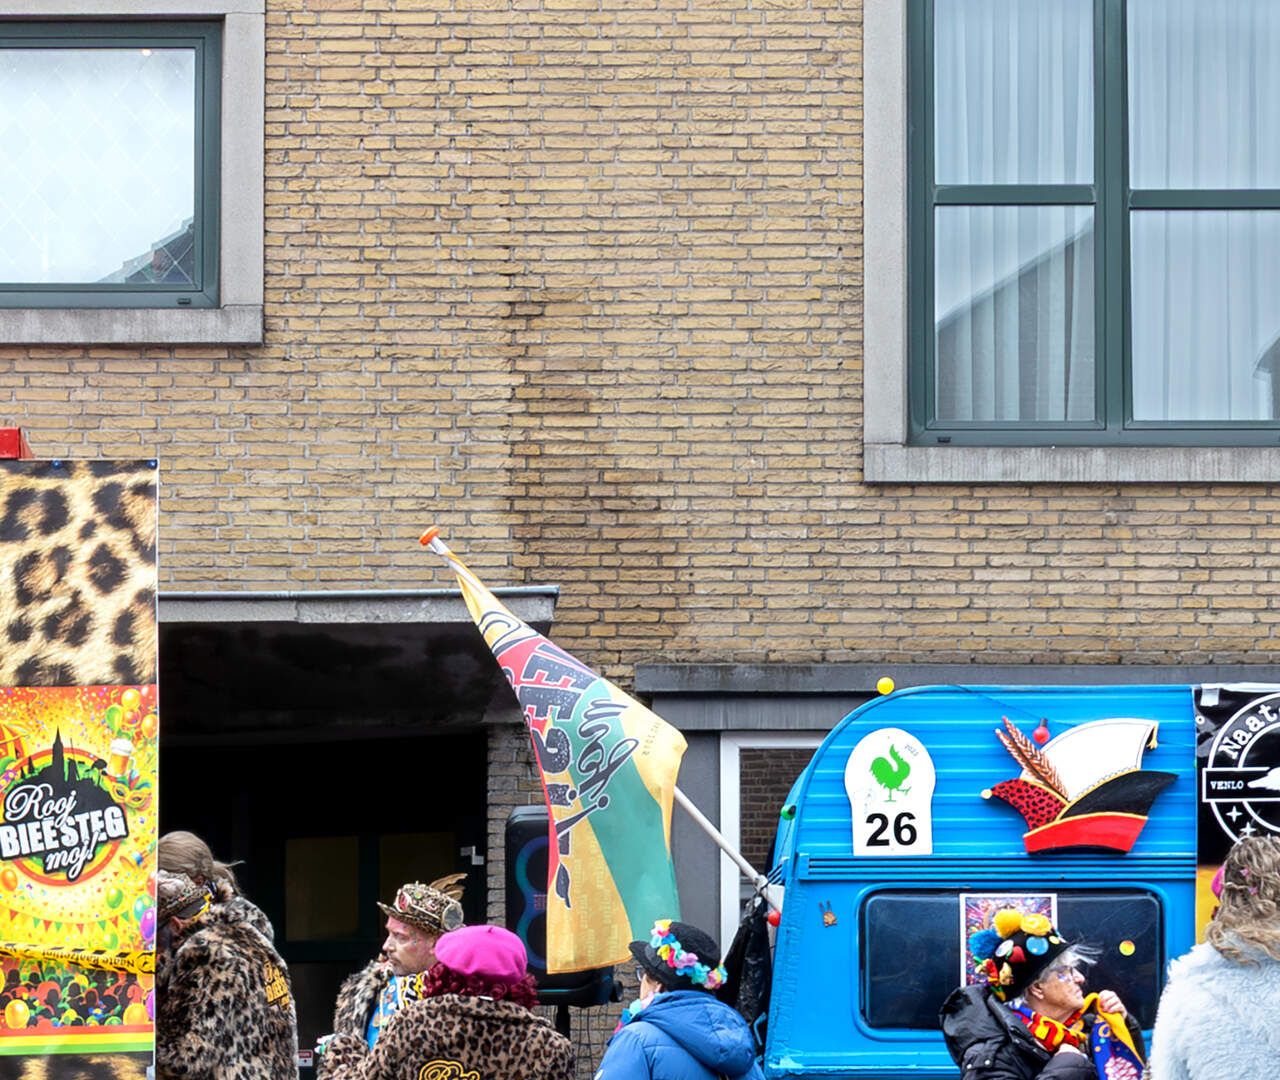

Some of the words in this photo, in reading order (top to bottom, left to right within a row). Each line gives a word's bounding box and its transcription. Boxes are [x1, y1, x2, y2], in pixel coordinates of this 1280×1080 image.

[5, 783, 77, 828] Rooj
[1210, 781, 1244, 790] VENLO
[865, 812, 918, 847] 26
[46, 830, 100, 879] moj!
